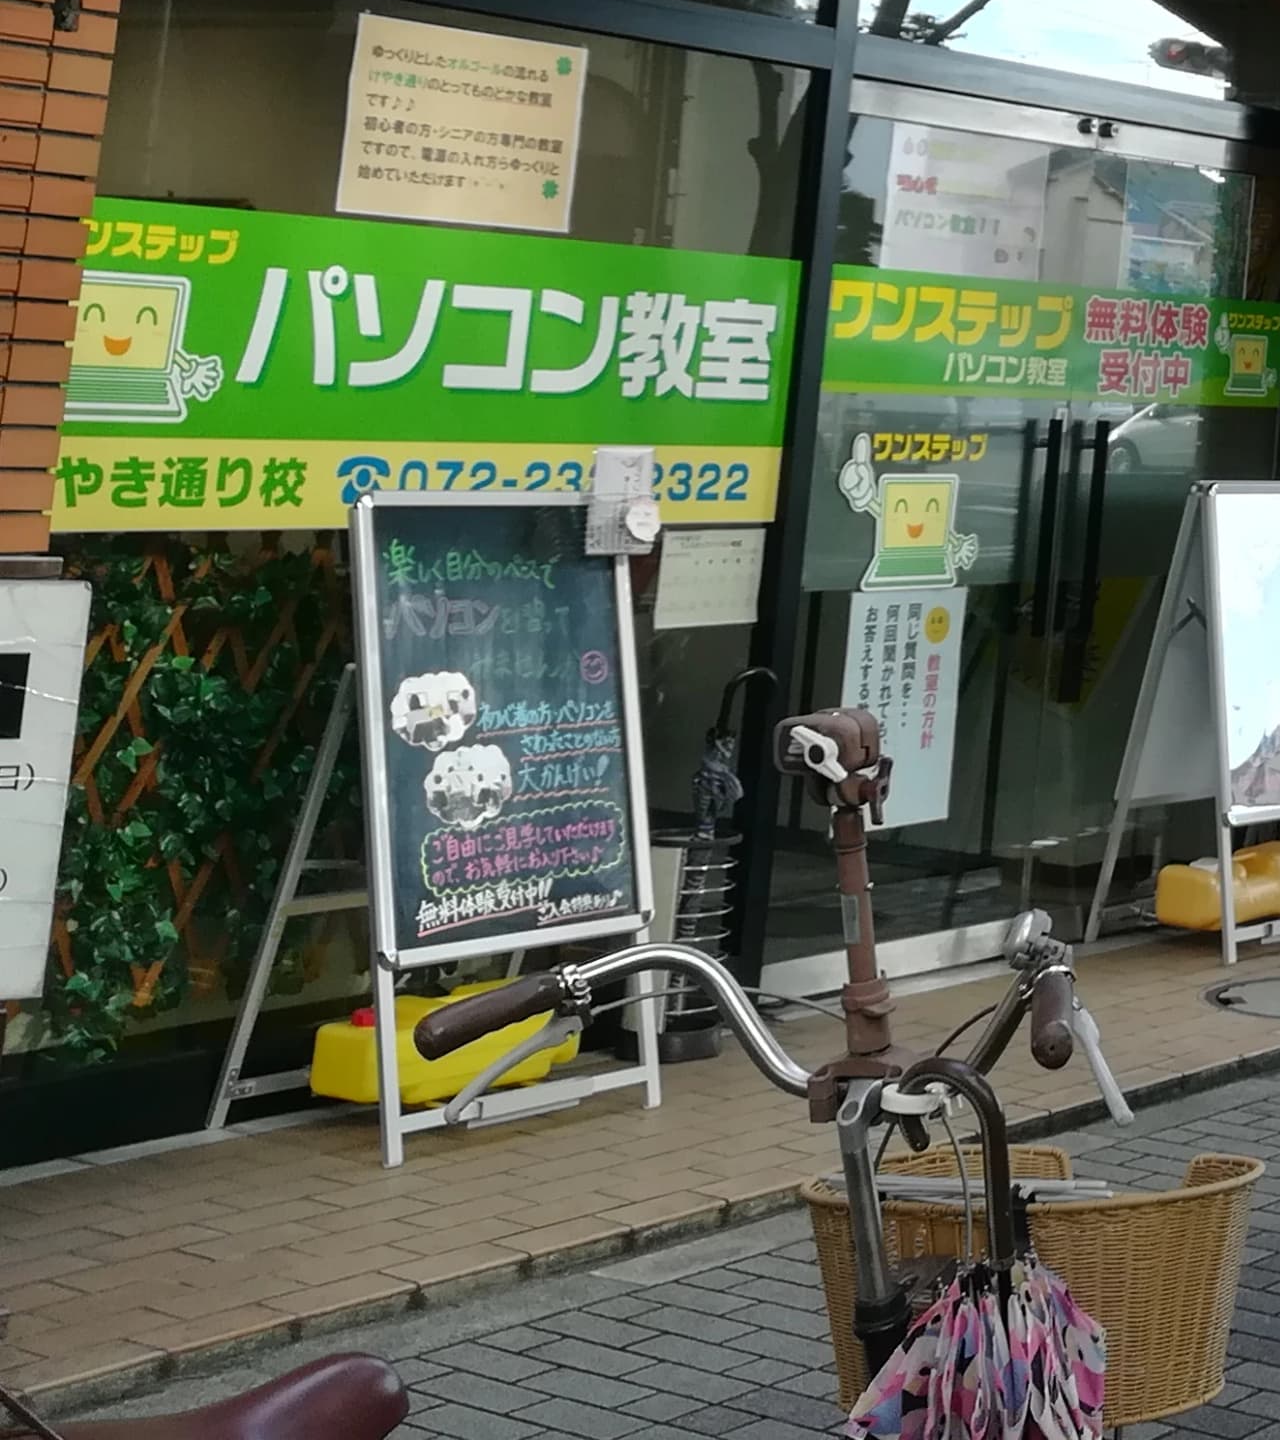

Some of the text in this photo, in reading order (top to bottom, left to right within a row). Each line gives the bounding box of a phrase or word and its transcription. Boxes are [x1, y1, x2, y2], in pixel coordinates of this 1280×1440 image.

[235, 265, 778, 401] パソコン教室
[831, 279, 1073, 350] ワンステップ
[1084, 295, 1211, 350] 無料体験
[943, 352, 1068, 386] パソコン教室
[1098, 348, 1192, 398] 受付中
[873, 433, 989, 463] ワンステップ
[55, 456, 308, 508] やき通り校
